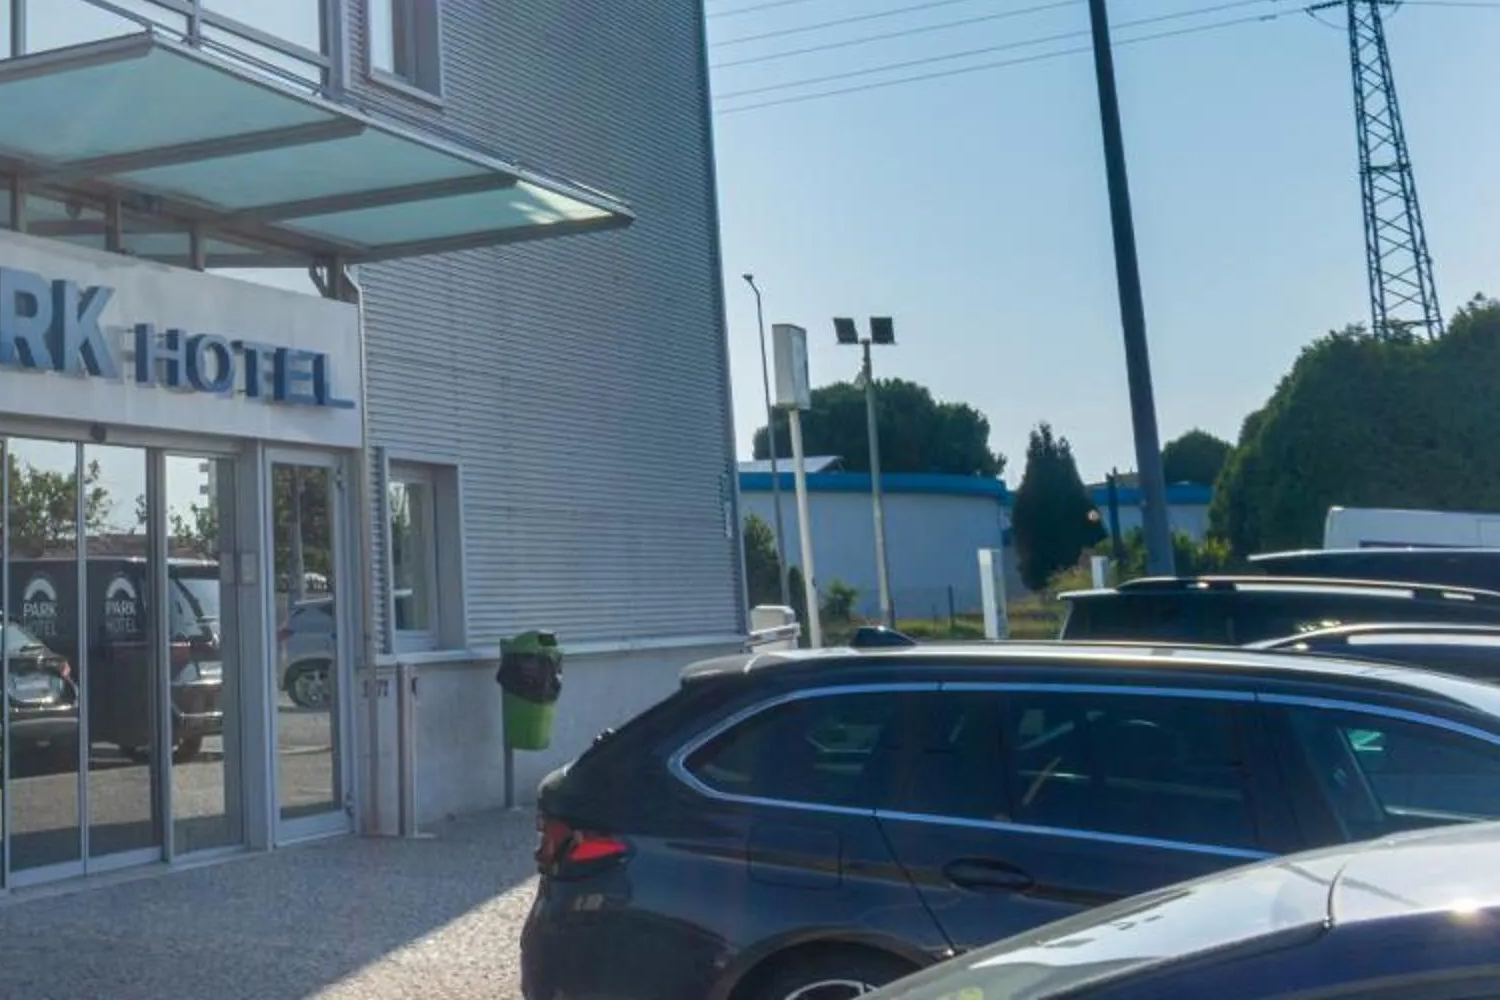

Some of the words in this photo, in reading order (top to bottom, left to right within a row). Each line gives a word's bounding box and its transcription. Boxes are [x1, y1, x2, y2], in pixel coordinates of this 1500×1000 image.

[134, 323, 356, 409] HOTEL
[23, 601, 57, 616] PARK
[105, 600, 137, 615] PARK
